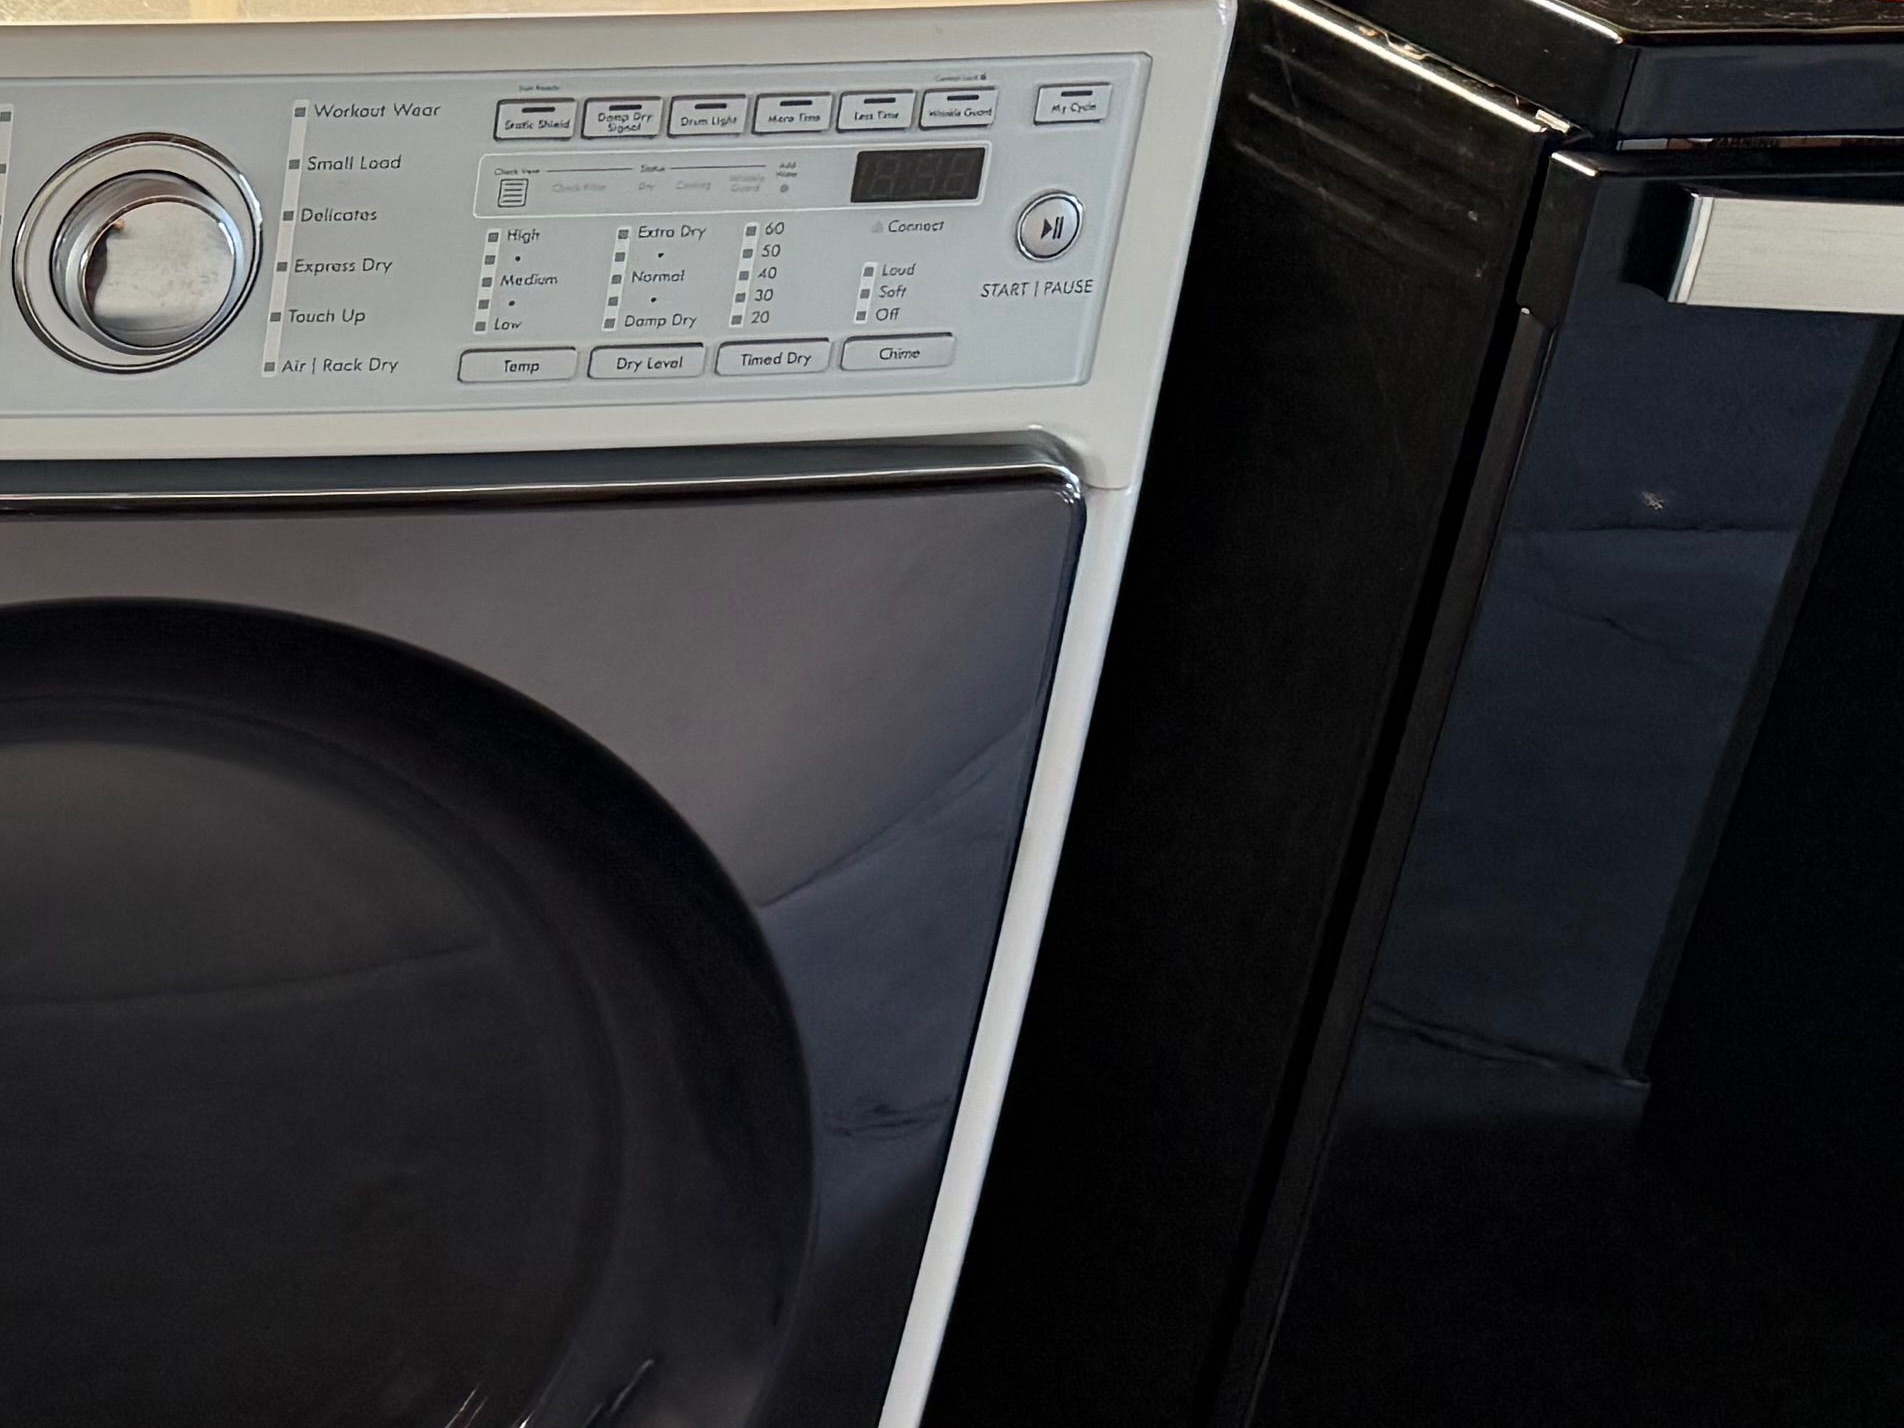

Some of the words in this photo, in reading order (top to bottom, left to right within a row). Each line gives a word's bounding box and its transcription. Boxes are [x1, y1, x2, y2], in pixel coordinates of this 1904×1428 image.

[314, 104, 386, 118] Workout
[680, 116, 708, 126] Drum
[712, 116, 738, 126] Light
[308, 156, 353, 170] Small
[361, 155, 402, 169] Load
[301, 208, 377, 222] Delicates
[638, 226, 674, 239] Extra
[681, 225, 707, 241] Dry
[765, 222, 784, 235] 60
[888, 220, 944, 233] Connect
[507, 229, 540, 245] High
[761, 245, 781, 257] 50
[294, 259, 355, 275] Express
[363, 258, 393, 273] Dry
[758, 267, 777, 279] 40
[882, 263, 916, 276] Loud
[500, 274, 558, 286] Medium
[631, 270, 685, 283] Normal
[754, 289, 773, 302] 30
[879, 286, 906, 298] Soft
[981, 282, 1030, 298] START
[1044, 280, 1093, 294] PAUSE
[288, 309, 334, 323] Touch
[342, 308, 366, 325] Up
[751, 311, 770, 323] 20
[876, 308, 900, 321] Off
[494, 318, 522, 331] Low
[624, 315, 666, 329] Damp
[672, 314, 697, 328] Dry
[282, 359, 306, 373] Air
[323, 359, 362, 372] Rack
[369, 358, 399, 374] Dry
[617, 358, 642, 372] Dry
[741, 353, 782, 366] Timed
[787, 352, 812, 367] Dry
[504, 360, 540, 375] Temp
